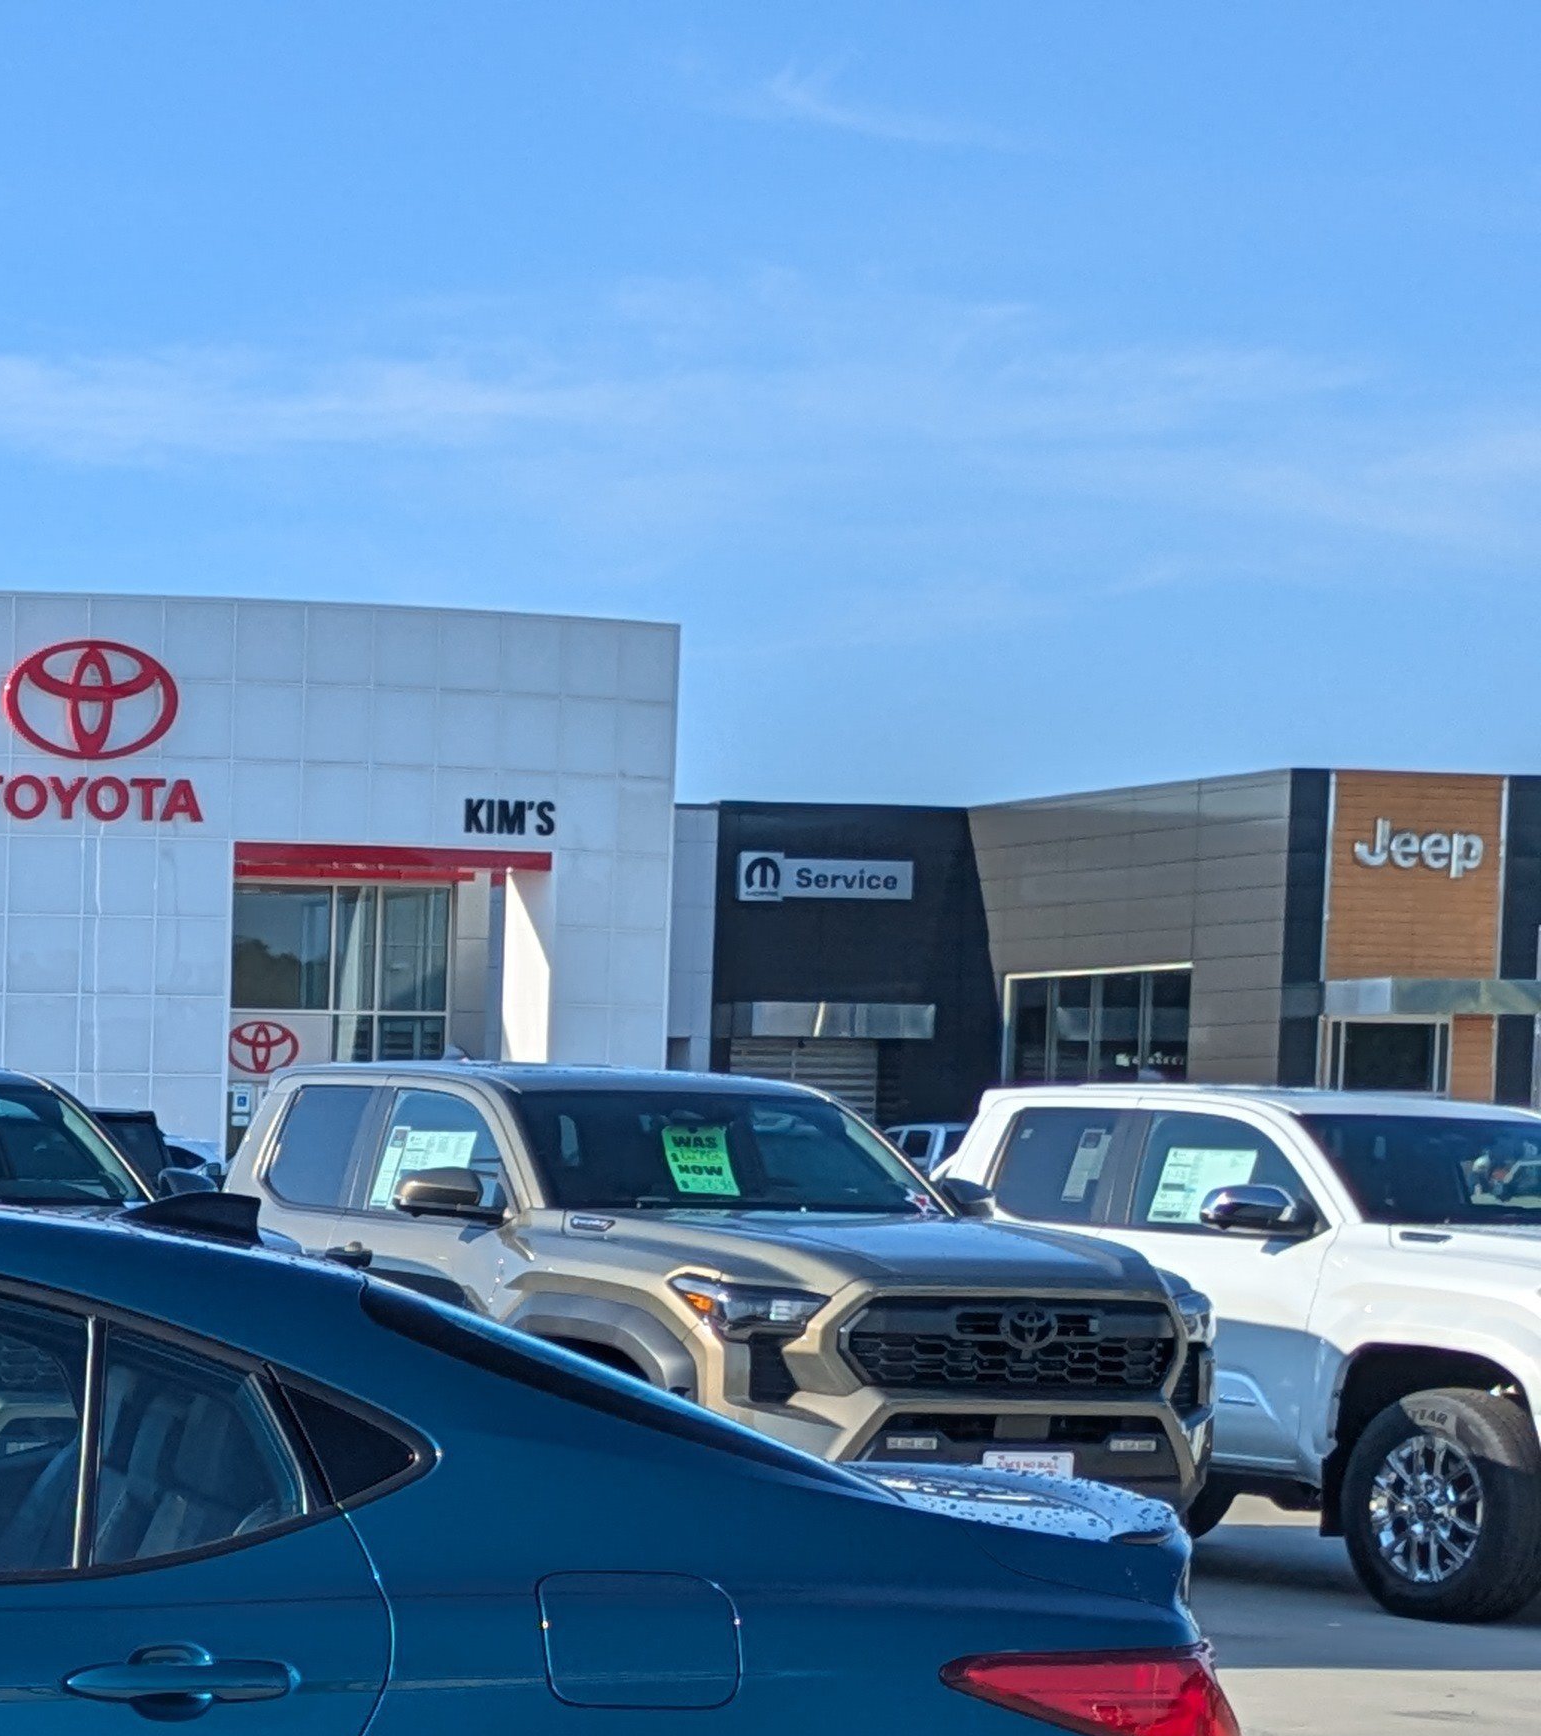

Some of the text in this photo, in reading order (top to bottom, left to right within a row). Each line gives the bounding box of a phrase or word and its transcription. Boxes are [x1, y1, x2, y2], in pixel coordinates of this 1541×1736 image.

[463, 798, 556, 836] KIM'S
[1353, 816, 1485, 879] Jeep
[795, 866, 898, 891] Service
[671, 1136, 718, 1149] WAS
[678, 1165, 723, 1176] NOW
